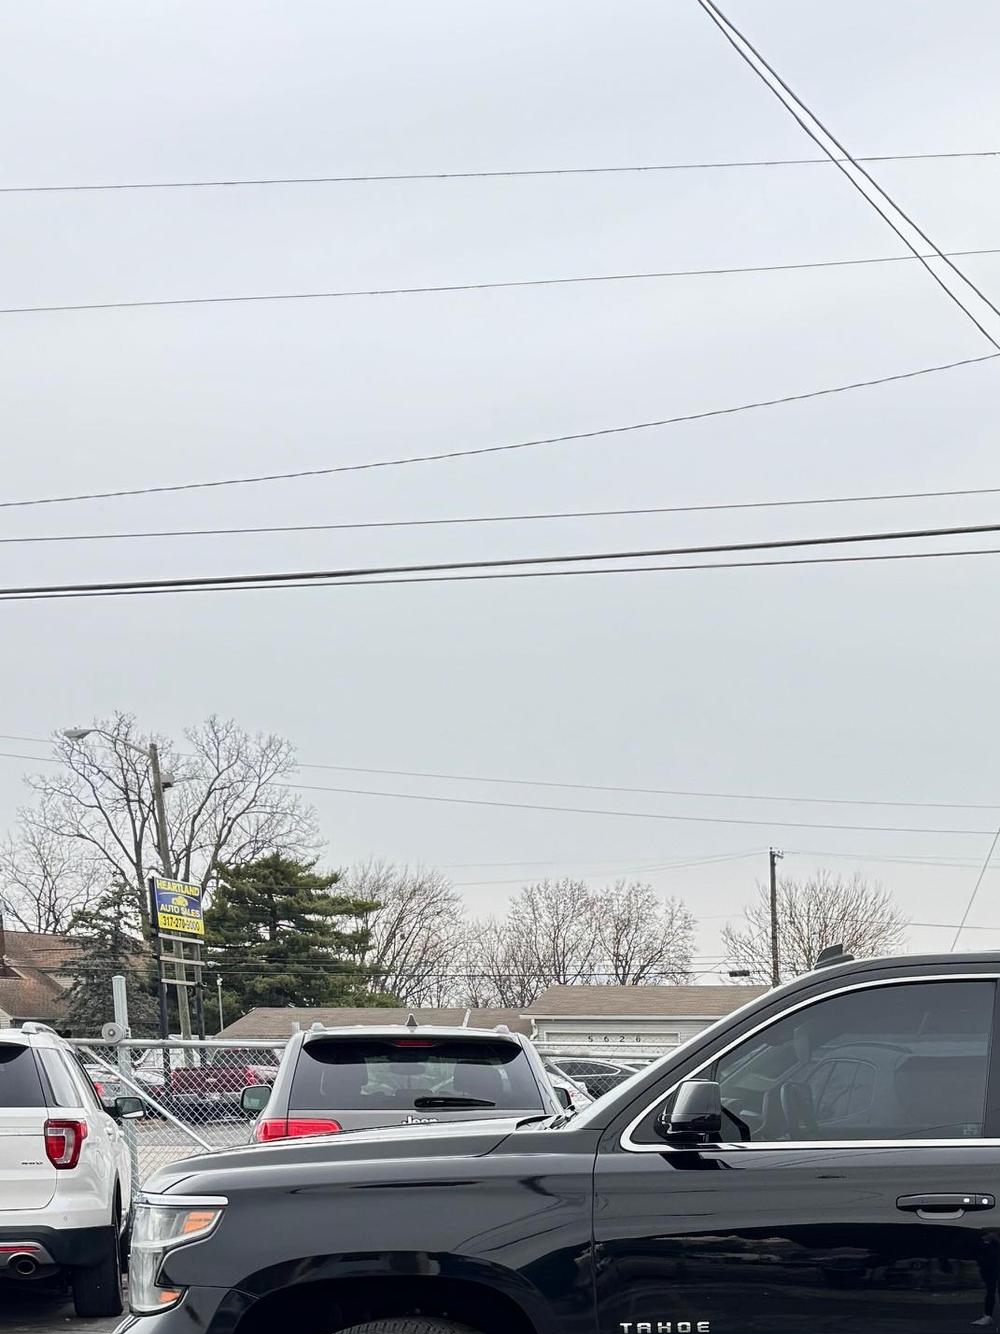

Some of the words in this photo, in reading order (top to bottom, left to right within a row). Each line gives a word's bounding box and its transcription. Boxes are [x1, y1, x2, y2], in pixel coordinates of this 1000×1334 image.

[156, 879, 200, 896] HEARTLAND
[160, 903, 180, 913] AUTO
[181, 907, 200, 918] SALES
[619, 1321, 710, 1334] TAHOE
